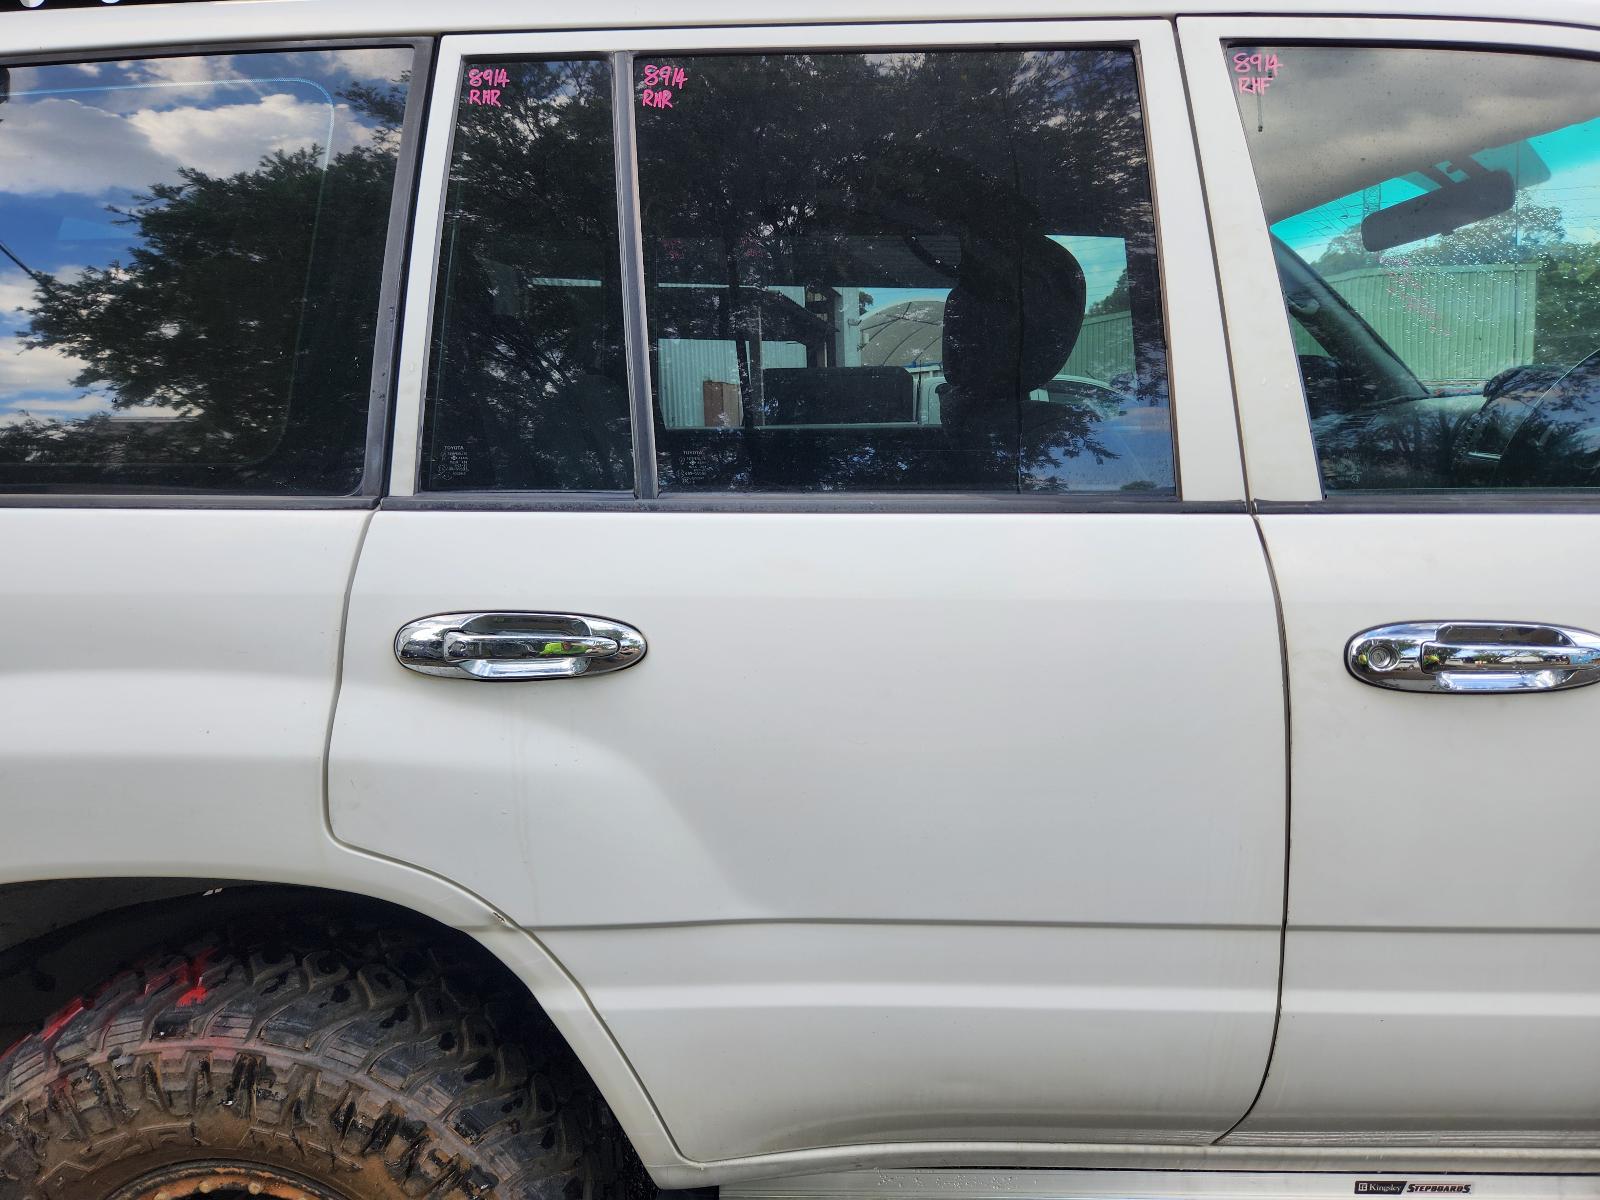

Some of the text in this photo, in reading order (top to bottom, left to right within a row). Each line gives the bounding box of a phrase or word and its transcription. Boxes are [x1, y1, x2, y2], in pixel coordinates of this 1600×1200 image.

[1232, 52, 1283, 76] 8914
[468, 68, 510, 87] 8914
[644, 64, 688, 89] 8914
[1238, 77, 1273, 96] RHF
[469, 89, 501, 107] RHR
[642, 89, 673, 109] RHR
[1368, 1183, 1472, 1194] Kingsley STEPBOARDS
